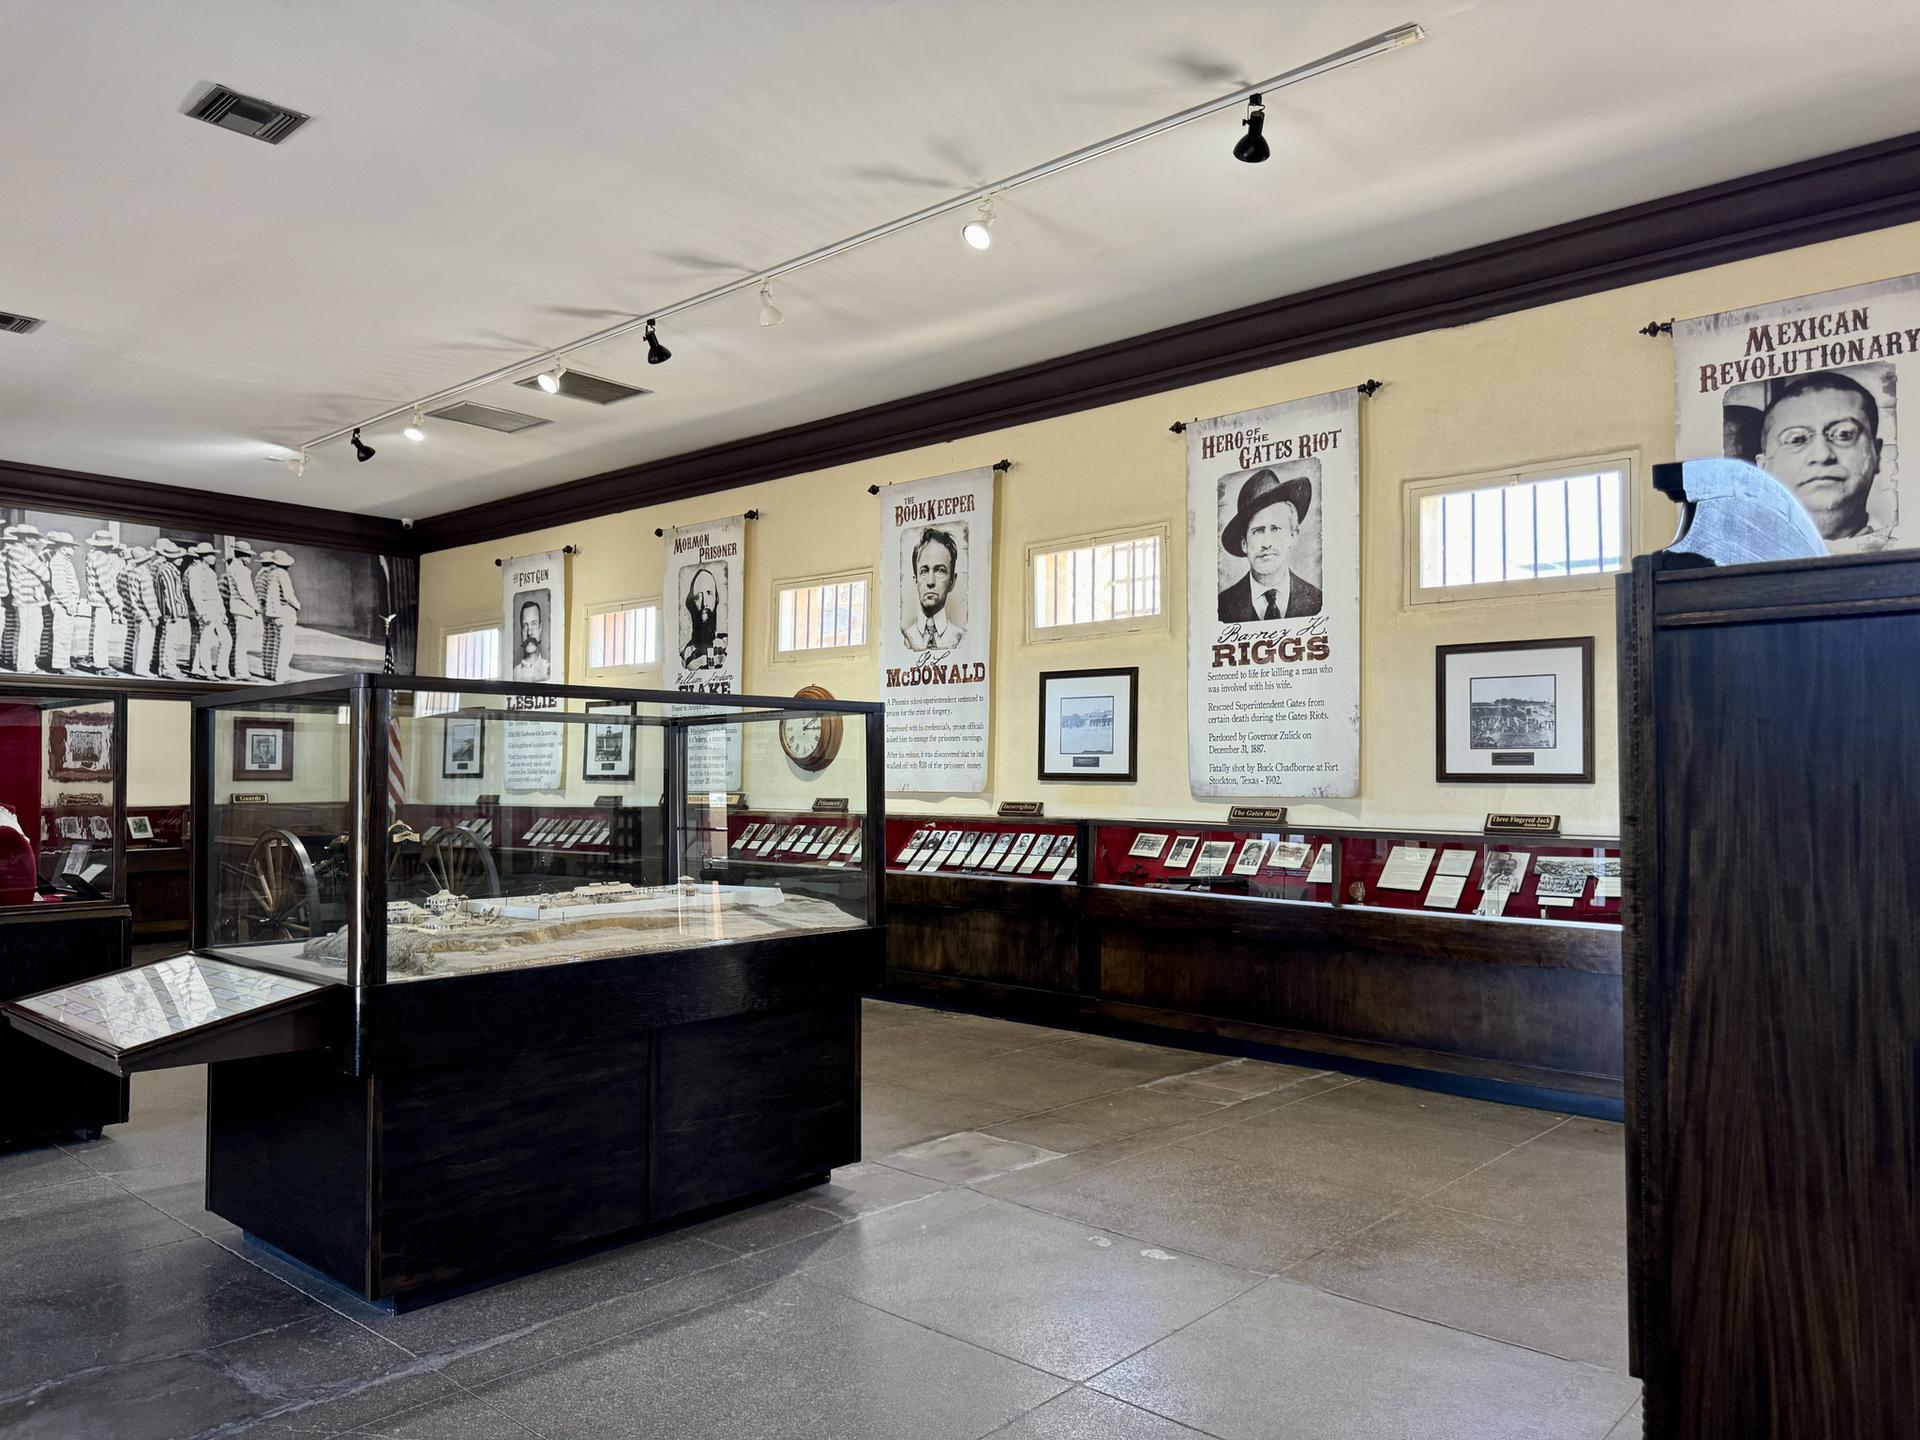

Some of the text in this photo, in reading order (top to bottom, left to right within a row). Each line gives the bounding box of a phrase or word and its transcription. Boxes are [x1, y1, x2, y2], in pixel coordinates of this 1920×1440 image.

[1744, 307, 1869, 357] MEXICAN
[1699, 328, 1920, 392] REVOLUTIONARY
[1246, 427, 1261, 436] OF
[1246, 434, 1269, 444] THE
[1201, 431, 1244, 460] HERO
[1239, 428, 1342, 469] GATES RIOT
[904, 496, 915, 505] THE
[674, 534, 709, 554] MORMON
[699, 543, 737, 563] PRISONER
[519, 571, 535, 587] FAST
[536, 569, 549, 584] GUN
[1217, 623, 1291, 647] Barney
[1212, 635, 1330, 668] RIGGS
[886, 662, 985, 687] McDONALD
[1207, 671, 1238, 681] Sentenced
[1249, 670, 1258, 678] life
[1260, 669, 1269, 677] for
[1272, 667, 1293, 677] killing
[1319, 665, 1333, 673] who
[1221, 683, 1247, 692] involved
[1248, 682, 1263, 691] with
[1265, 681, 1274, 689] his
[1276, 680, 1292, 689] wife.
[507, 696, 557, 713] LESLIE
[1208, 698, 1324, 712] Rescued Superintendent Gates from
[1208, 710, 1329, 723] certain death during the Gates Riots.
[1209, 733, 1237, 742] Pardoned
[1239, 732, 1245, 742] by
[1248, 732, 1278, 741] Governor
[1280, 730, 1301, 740] Zulick
[1209, 745, 1239, 754] December
[1251, 744, 1266, 753] 1887.
[1209, 764, 1230, 773] Fatally
[1232, 764, 1245, 772] shot
[1247, 763, 1254, 773] by
[1257, 763, 1273, 772] Buck
[1324, 762, 1338, 771] Fort
[1209, 776, 1238, 785] Stockton,
[1240, 775, 1259, 784] Texas
[1266, 775, 1282, 785] 1902.
